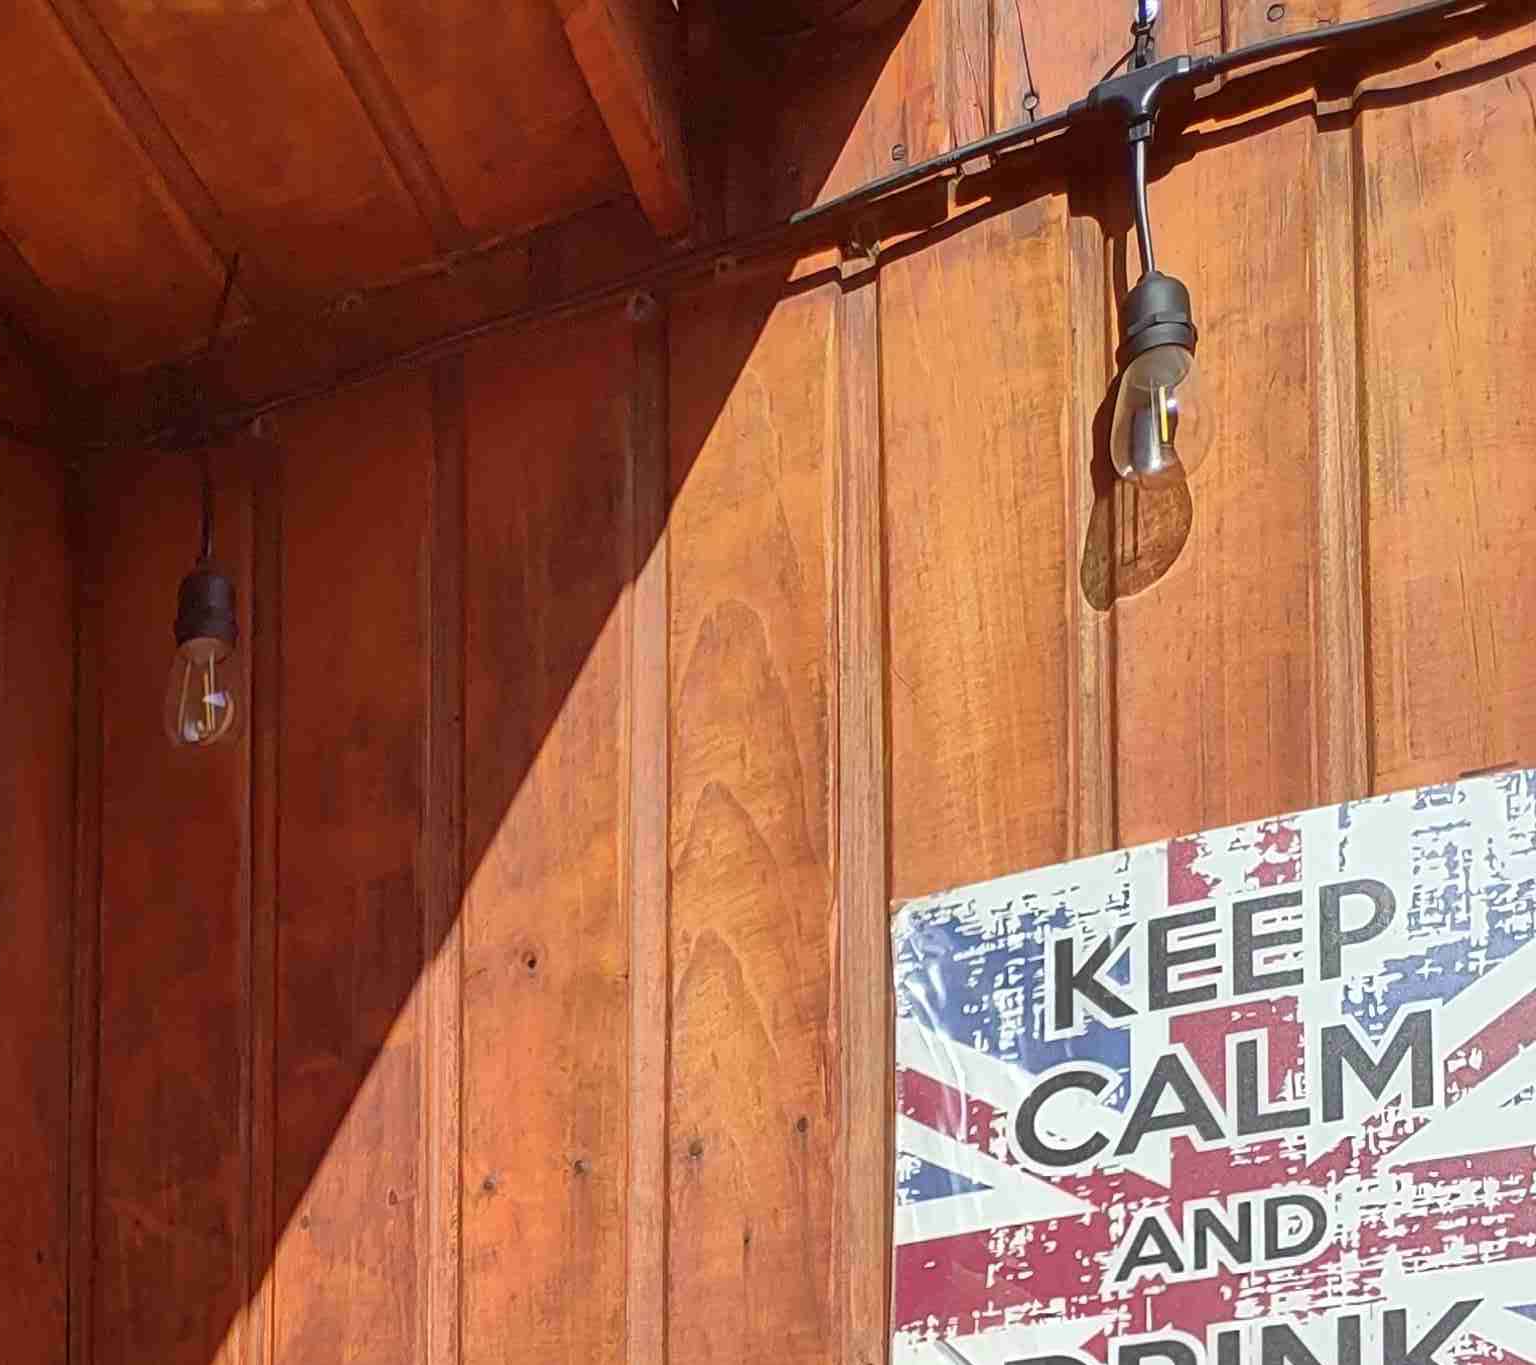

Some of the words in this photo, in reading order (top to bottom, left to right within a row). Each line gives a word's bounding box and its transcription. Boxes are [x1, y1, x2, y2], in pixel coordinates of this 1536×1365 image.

[1054, 877, 1397, 1031] KEEP
[1015, 1009, 1433, 1166] CALM
[1115, 1192, 1329, 1283] AND
